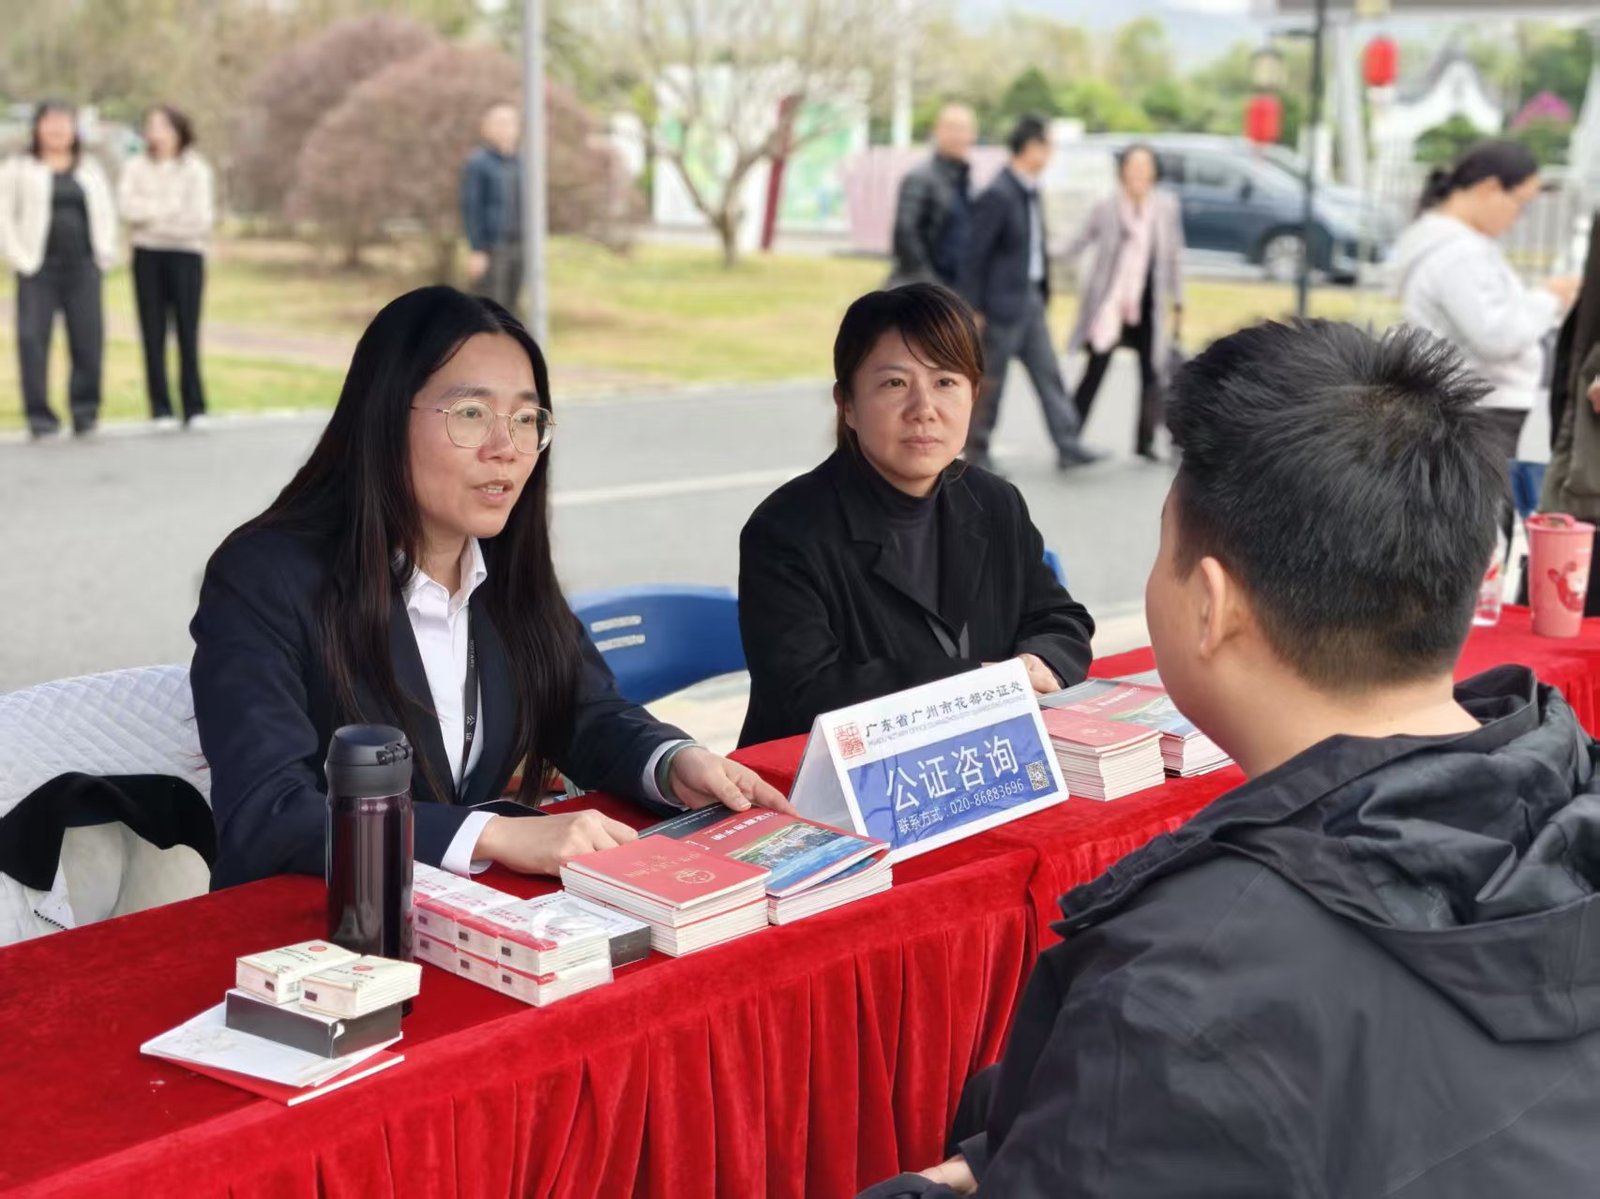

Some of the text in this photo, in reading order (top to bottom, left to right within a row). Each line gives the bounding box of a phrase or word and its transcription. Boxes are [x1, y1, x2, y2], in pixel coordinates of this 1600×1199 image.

[866, 681, 1024, 737] 广东省广州市花都公证处
[886, 735, 1018, 812] 公证咨询
